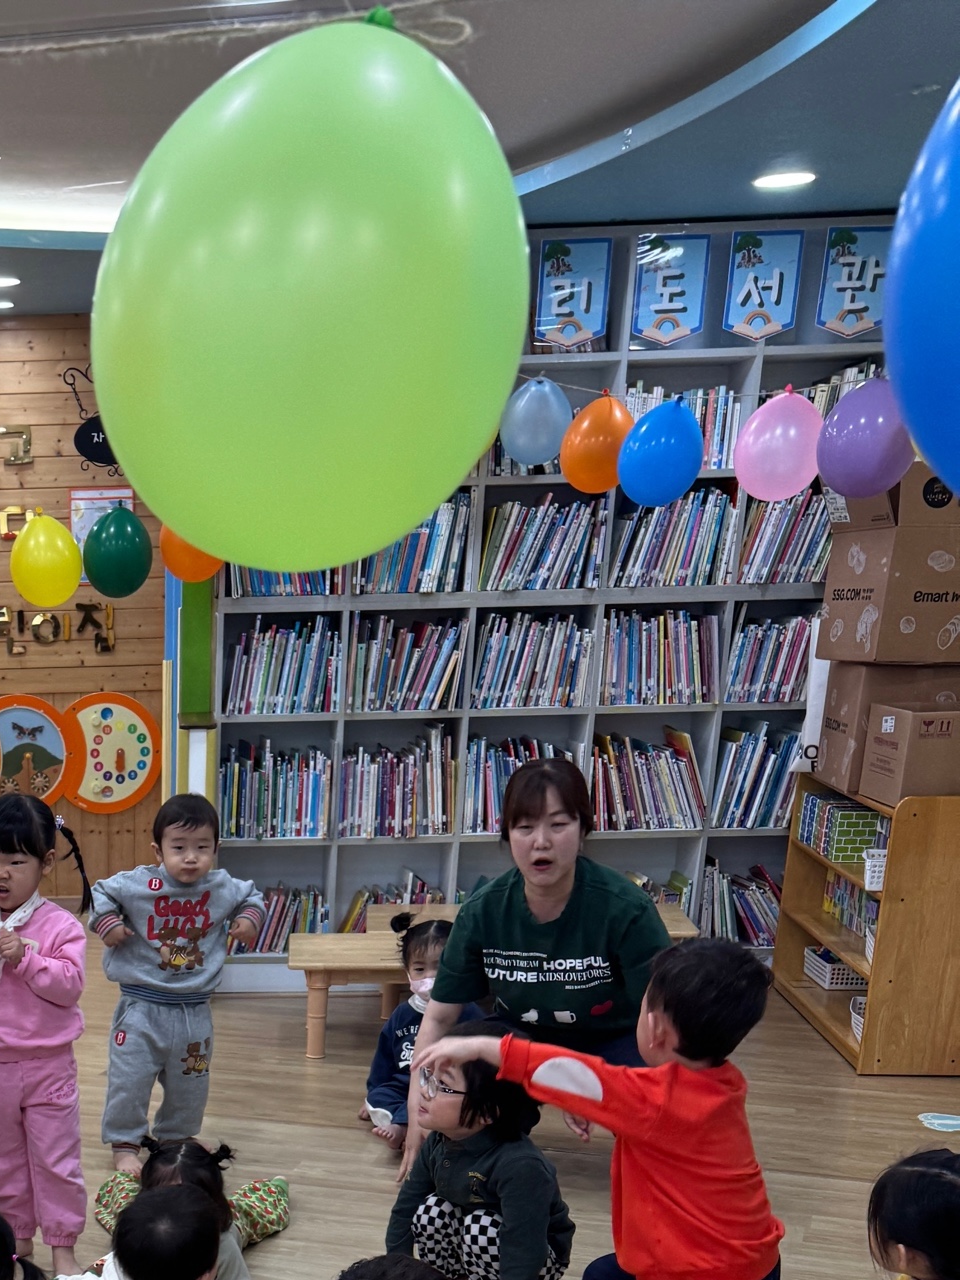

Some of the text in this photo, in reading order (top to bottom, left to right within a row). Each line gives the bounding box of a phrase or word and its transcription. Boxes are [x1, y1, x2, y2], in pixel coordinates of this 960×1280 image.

[832, 588, 861, 601] SSG.COM
[913, 590, 949, 603] emart
[155, 891, 210, 917] Good
[543, 956, 610, 971] HOPEFUL
